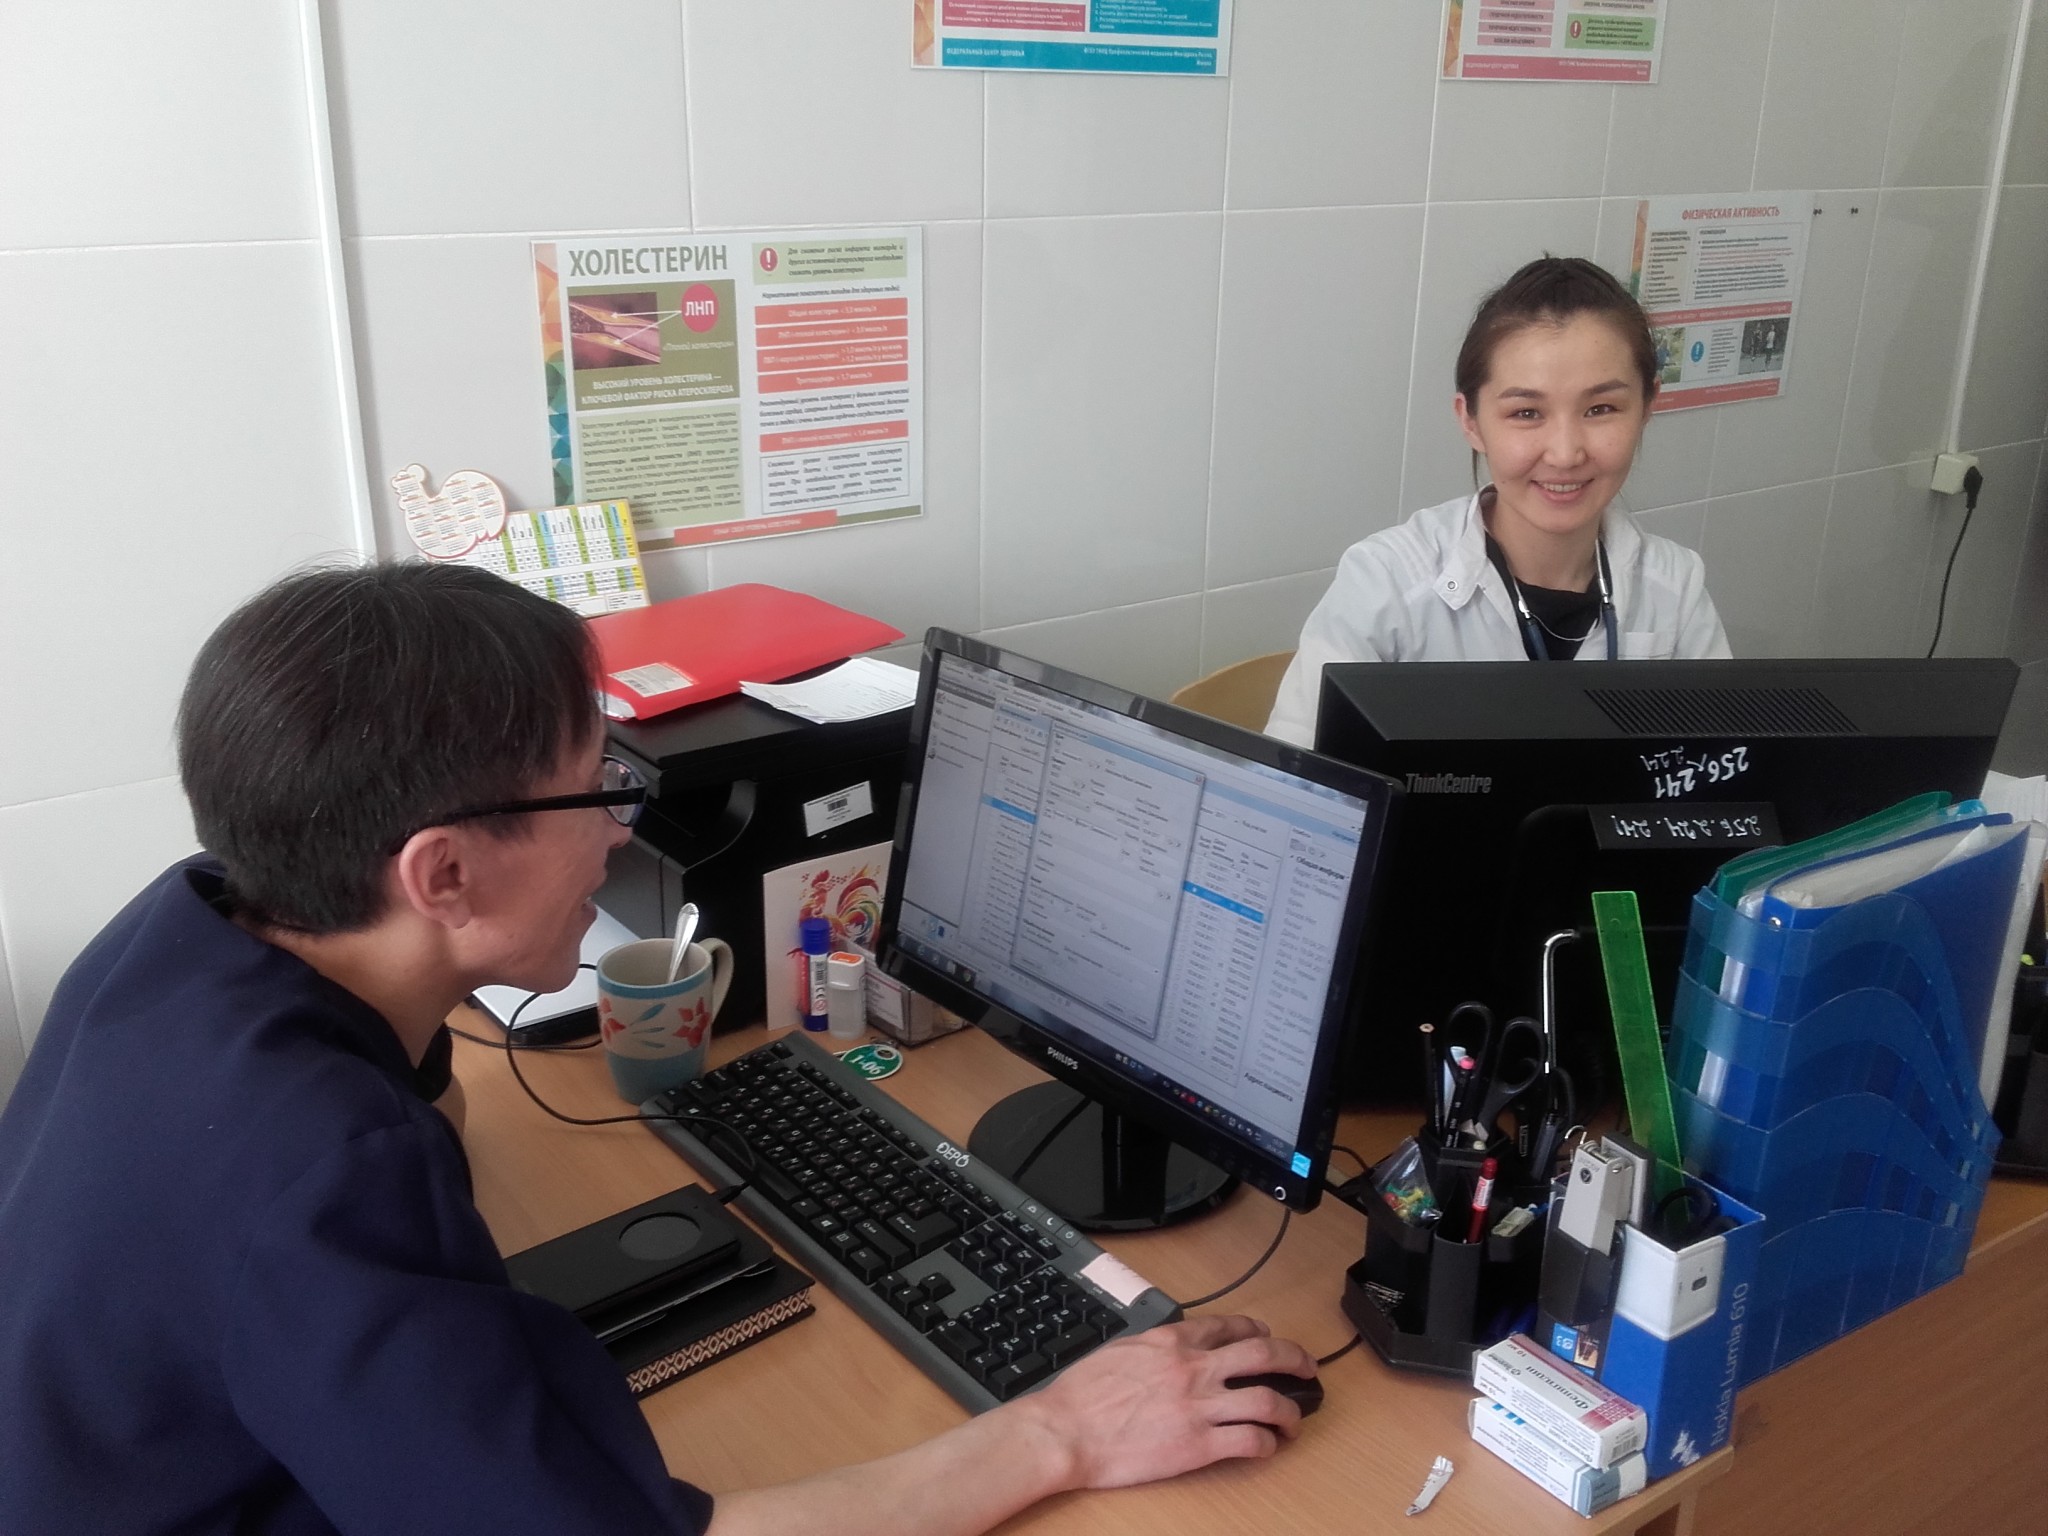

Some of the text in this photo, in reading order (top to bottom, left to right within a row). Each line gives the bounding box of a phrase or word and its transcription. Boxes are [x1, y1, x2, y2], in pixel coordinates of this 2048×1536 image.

[1682, 206, 1780, 220] ФИЗИЧЕСКАЯ АКТИВНОСТЬ
[569, 245, 727, 276] ХОЛЕСТЕРИН
[685, 301, 714, 317] ЛНП
[1405, 773, 1492, 794] ThinkCentre
[1654, 768, 1696, 798] 241
[850, 1054, 882, 1076] 1-06
[1046, 1046, 1079, 1070] PHILIPS
[935, 1141, 970, 1167] DEPO
[1710, 1283, 1749, 1447] Nokia Lumia 610
[1526, 1365, 1589, 1410] Фенигидин
